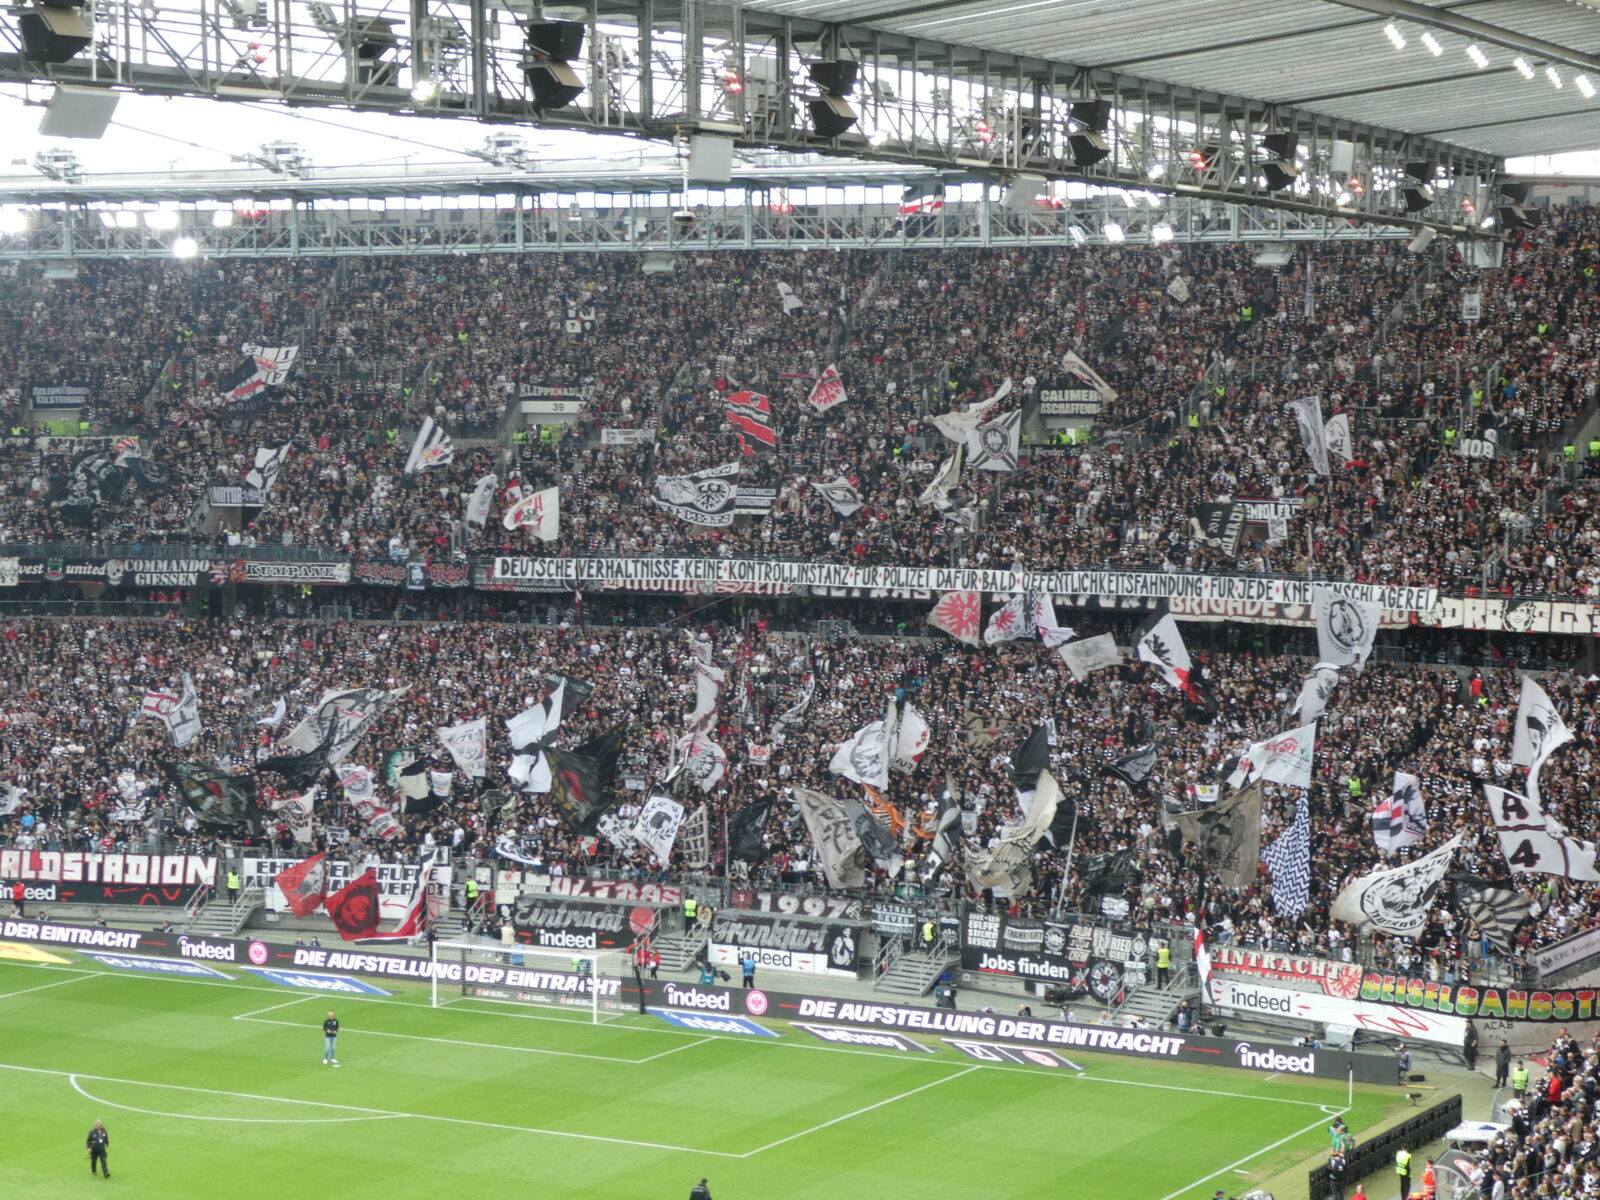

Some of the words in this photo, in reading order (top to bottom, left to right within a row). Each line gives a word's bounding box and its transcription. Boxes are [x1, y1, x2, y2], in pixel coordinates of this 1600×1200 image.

[552, 403, 565, 411] 39
[1040, 390, 1101, 402] CALIMER
[66, 561, 106, 576] united
[124, 559, 210, 573] COMMANDO
[135, 572, 199, 586] GIESSEN
[502, 558, 572, 577] DEUTSCHE
[685, 560, 723, 579] KEINE
[728, 561, 849, 585] KONTROLLINSTANZ
[854, 567, 880, 586] FÜR
[936, 569, 978, 590] DAFÜR
[982, 571, 1016, 591] BALD
[1210, 578, 1235, 599] FÜR
[1238, 579, 1274, 601] JEDE
[0, 881, 56, 901] ineed
[551, 876, 681, 904] ULTRAS
[756, 893, 849, 918] 1997
[4, 921, 39, 939] DER
[39, 925, 142, 949] EINTRACHT
[177, 935, 235, 961] indeed
[536, 928, 597, 949] indeed
[294, 949, 327, 966] DIE
[326, 952, 462, 981] AUFSTELLUNG
[464, 965, 504, 984] DER
[978, 953, 1016, 972] Jobs
[1017, 956, 1070, 979] finden
[1209, 947, 1341, 979] EINTRACHT
[663, 983, 730, 1011] indeed
[1229, 984, 1291, 1013] indeed
[1360, 972, 1600, 1020] GEISELGANGST
[799, 998, 836, 1018] DIE
[836, 1002, 996, 1036] AUFSTELLUNG
[998, 1019, 1048, 1041] DER
[1047, 1024, 1186, 1056] EINTRACHT
[1234, 1042, 1315, 1074] indeed
